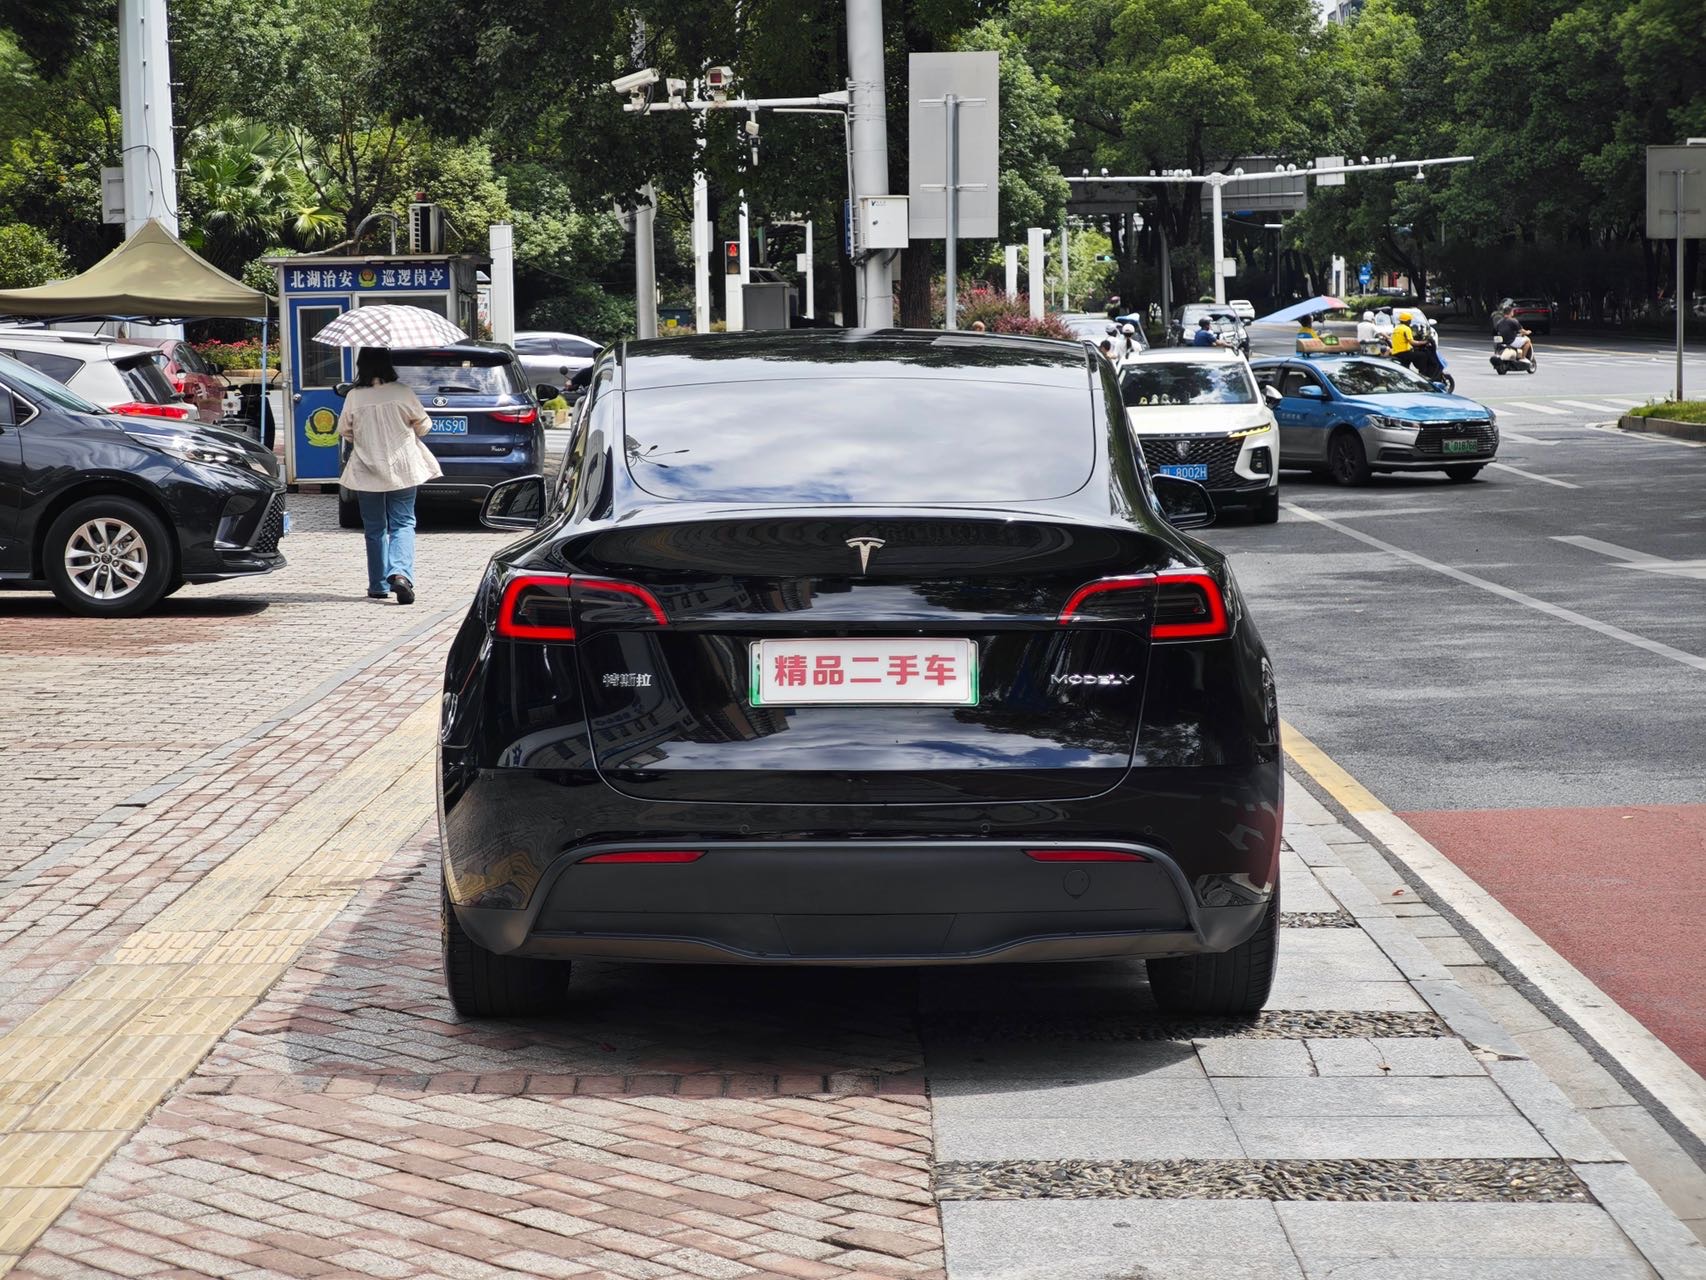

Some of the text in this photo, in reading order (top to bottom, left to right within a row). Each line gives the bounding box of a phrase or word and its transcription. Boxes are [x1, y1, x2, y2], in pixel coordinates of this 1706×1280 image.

[290, 268, 444, 288] 北湖治安 巡逻岗亭
[432, 420, 466, 432] 3KS90
[774, 655, 957, 687] 精品二手车
[603, 673, 652, 687] 特斯拉
